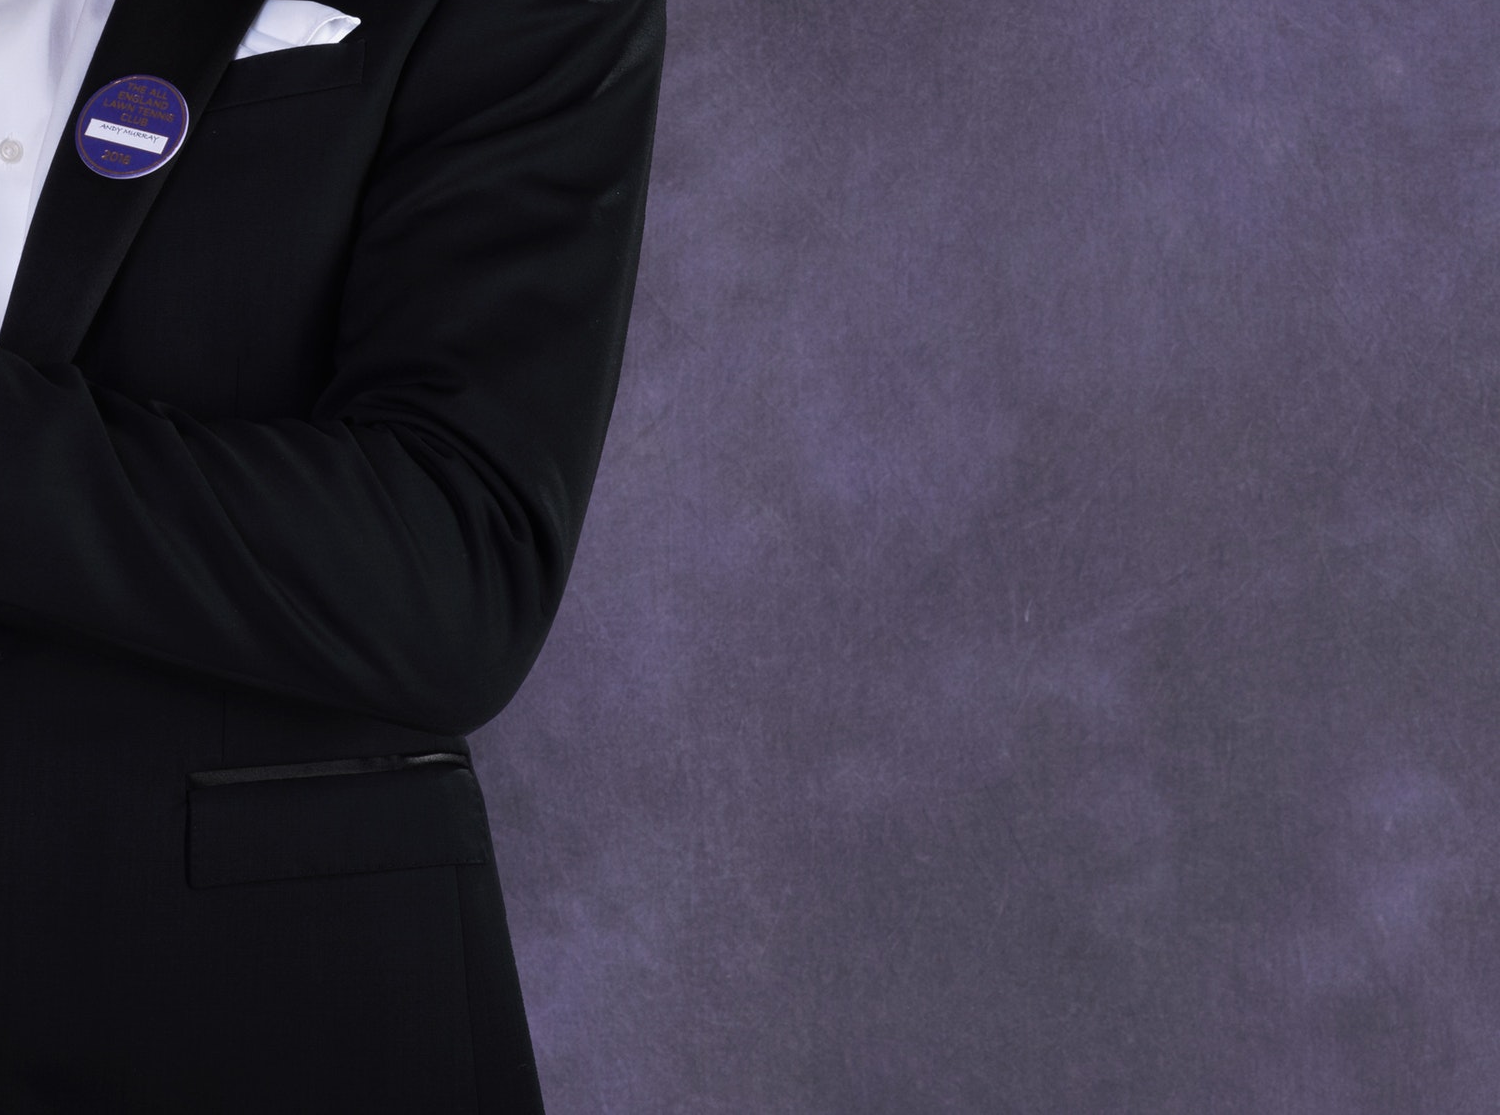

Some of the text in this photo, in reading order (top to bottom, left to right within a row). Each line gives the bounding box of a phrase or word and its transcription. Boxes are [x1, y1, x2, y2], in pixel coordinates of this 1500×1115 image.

[118, 91, 170, 110] ENGLAND
[128, 83, 168, 101] THE ALL
[103, 97, 175, 123] LAWN TENNIS
[120, 113, 148, 127] CLUB
[100, 123, 160, 144] ANDY MURRAY
